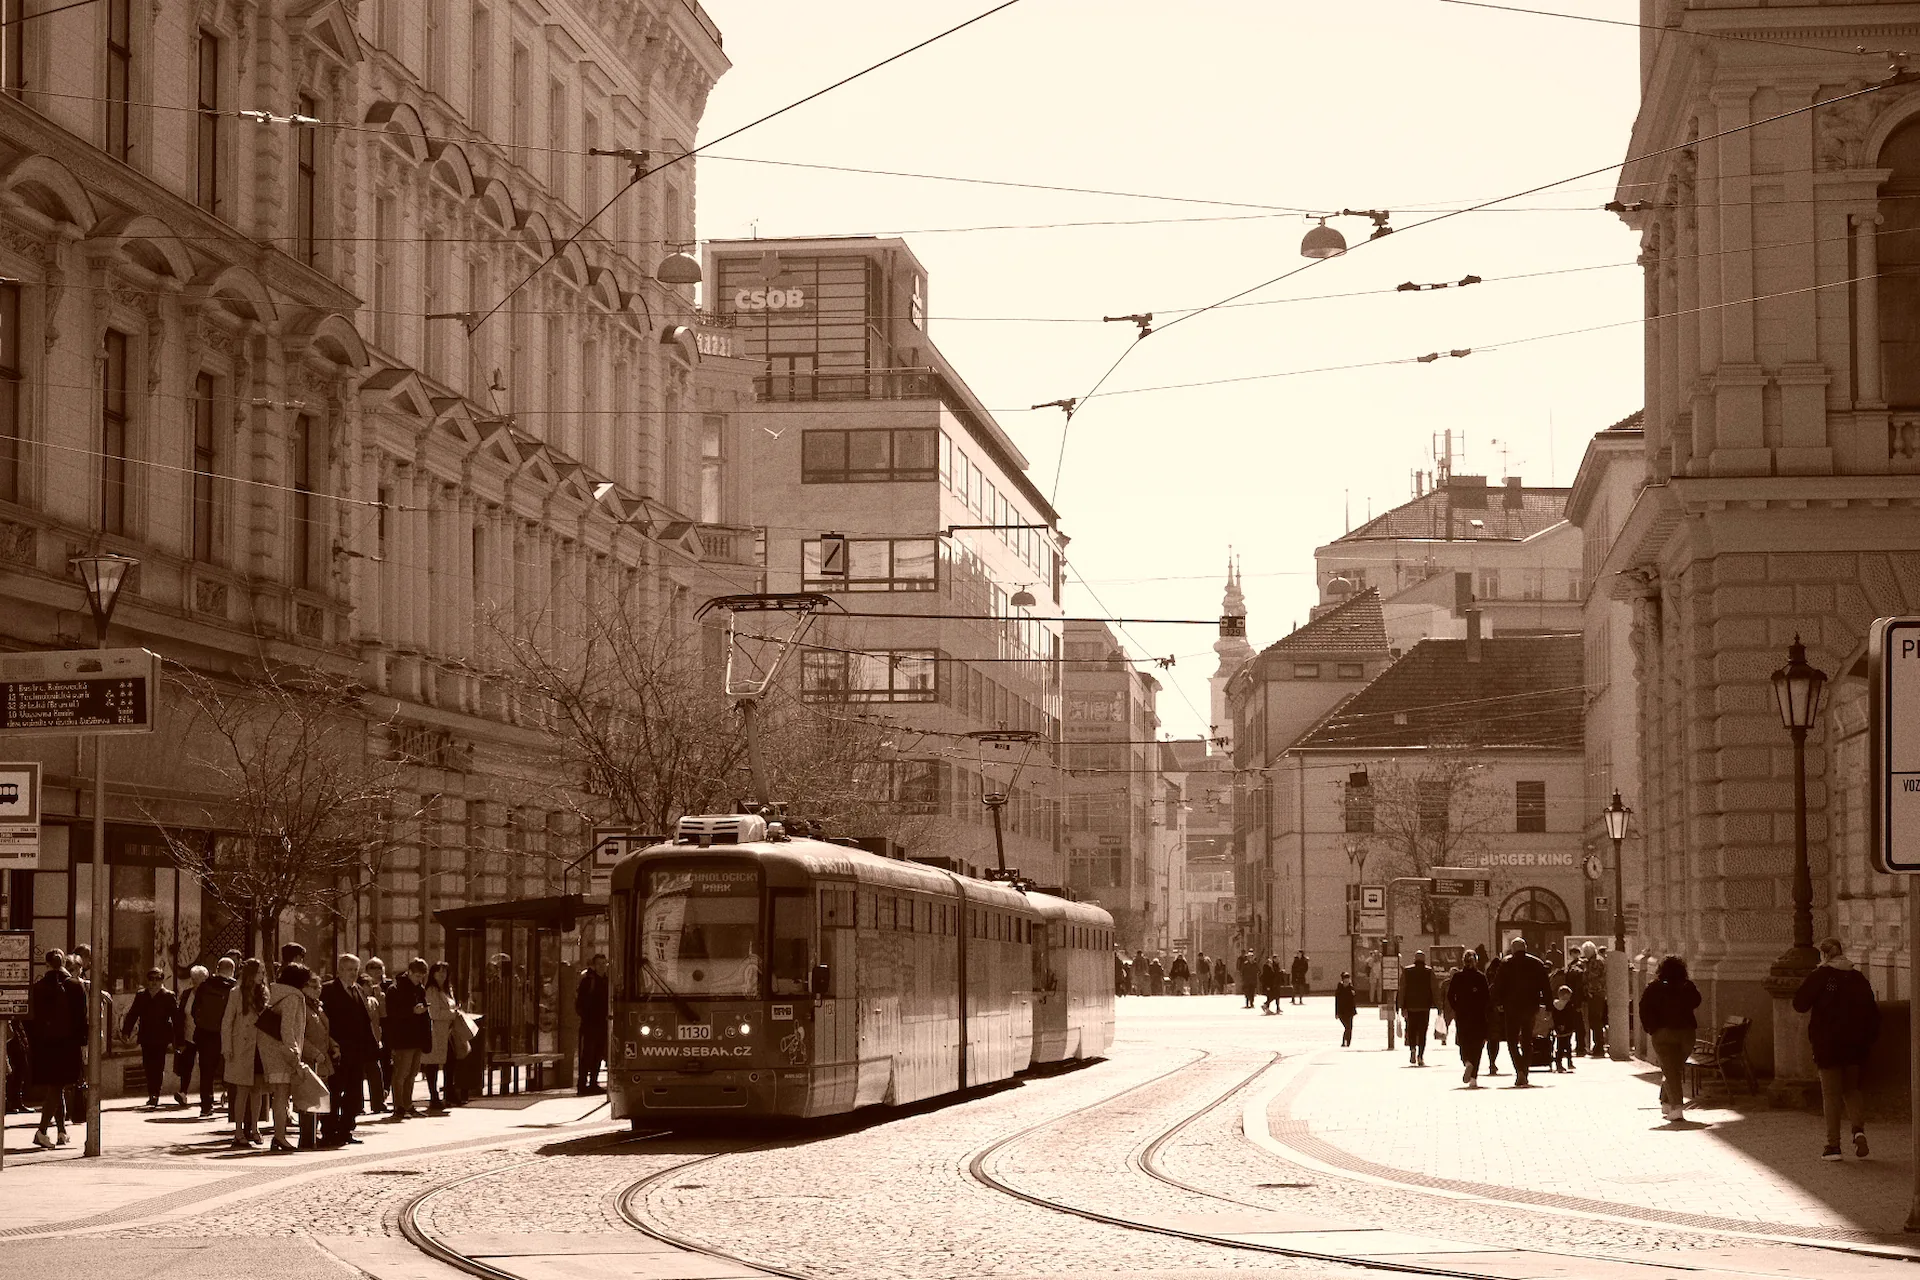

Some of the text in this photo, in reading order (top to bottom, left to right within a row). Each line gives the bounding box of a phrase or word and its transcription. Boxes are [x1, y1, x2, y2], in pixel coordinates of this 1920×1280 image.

[735, 288, 804, 309] ČSOB
[1480, 853, 1535, 866] BURGER
[1537, 853, 1573, 866] KING
[703, 883, 731, 892] PARK
[679, 1026, 709, 1039] 1130
